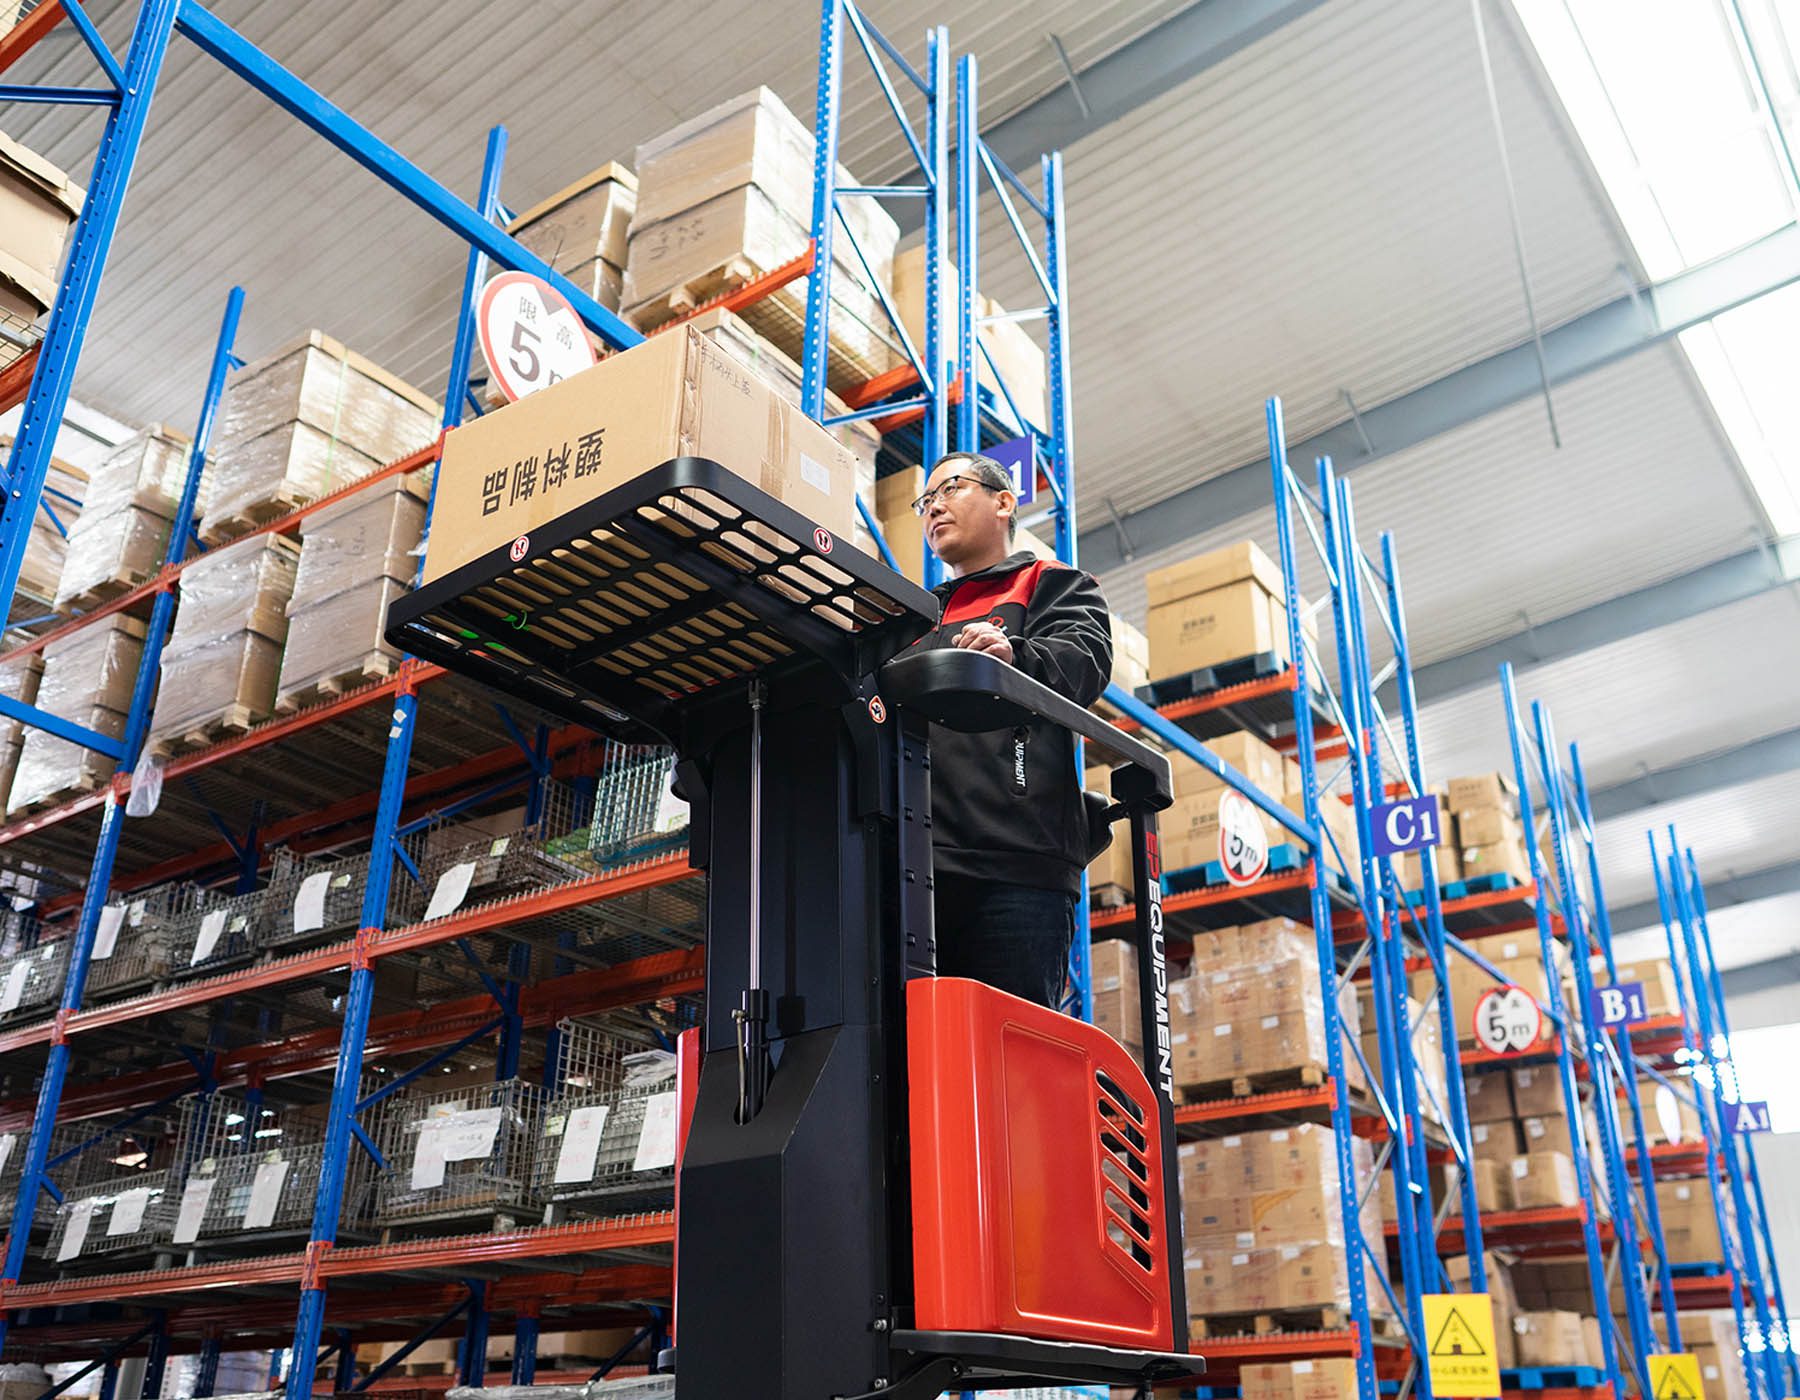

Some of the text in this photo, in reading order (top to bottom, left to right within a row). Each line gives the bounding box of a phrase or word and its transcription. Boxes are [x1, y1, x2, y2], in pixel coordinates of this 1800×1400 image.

[482, 428, 606, 517] 塑料制品
[1386, 804, 1436, 846] C1
[1145, 831, 1175, 1102] EP EQUIPMENT
[1600, 988, 1644, 1024] B1
[1735, 1103, 1770, 1131] A1
